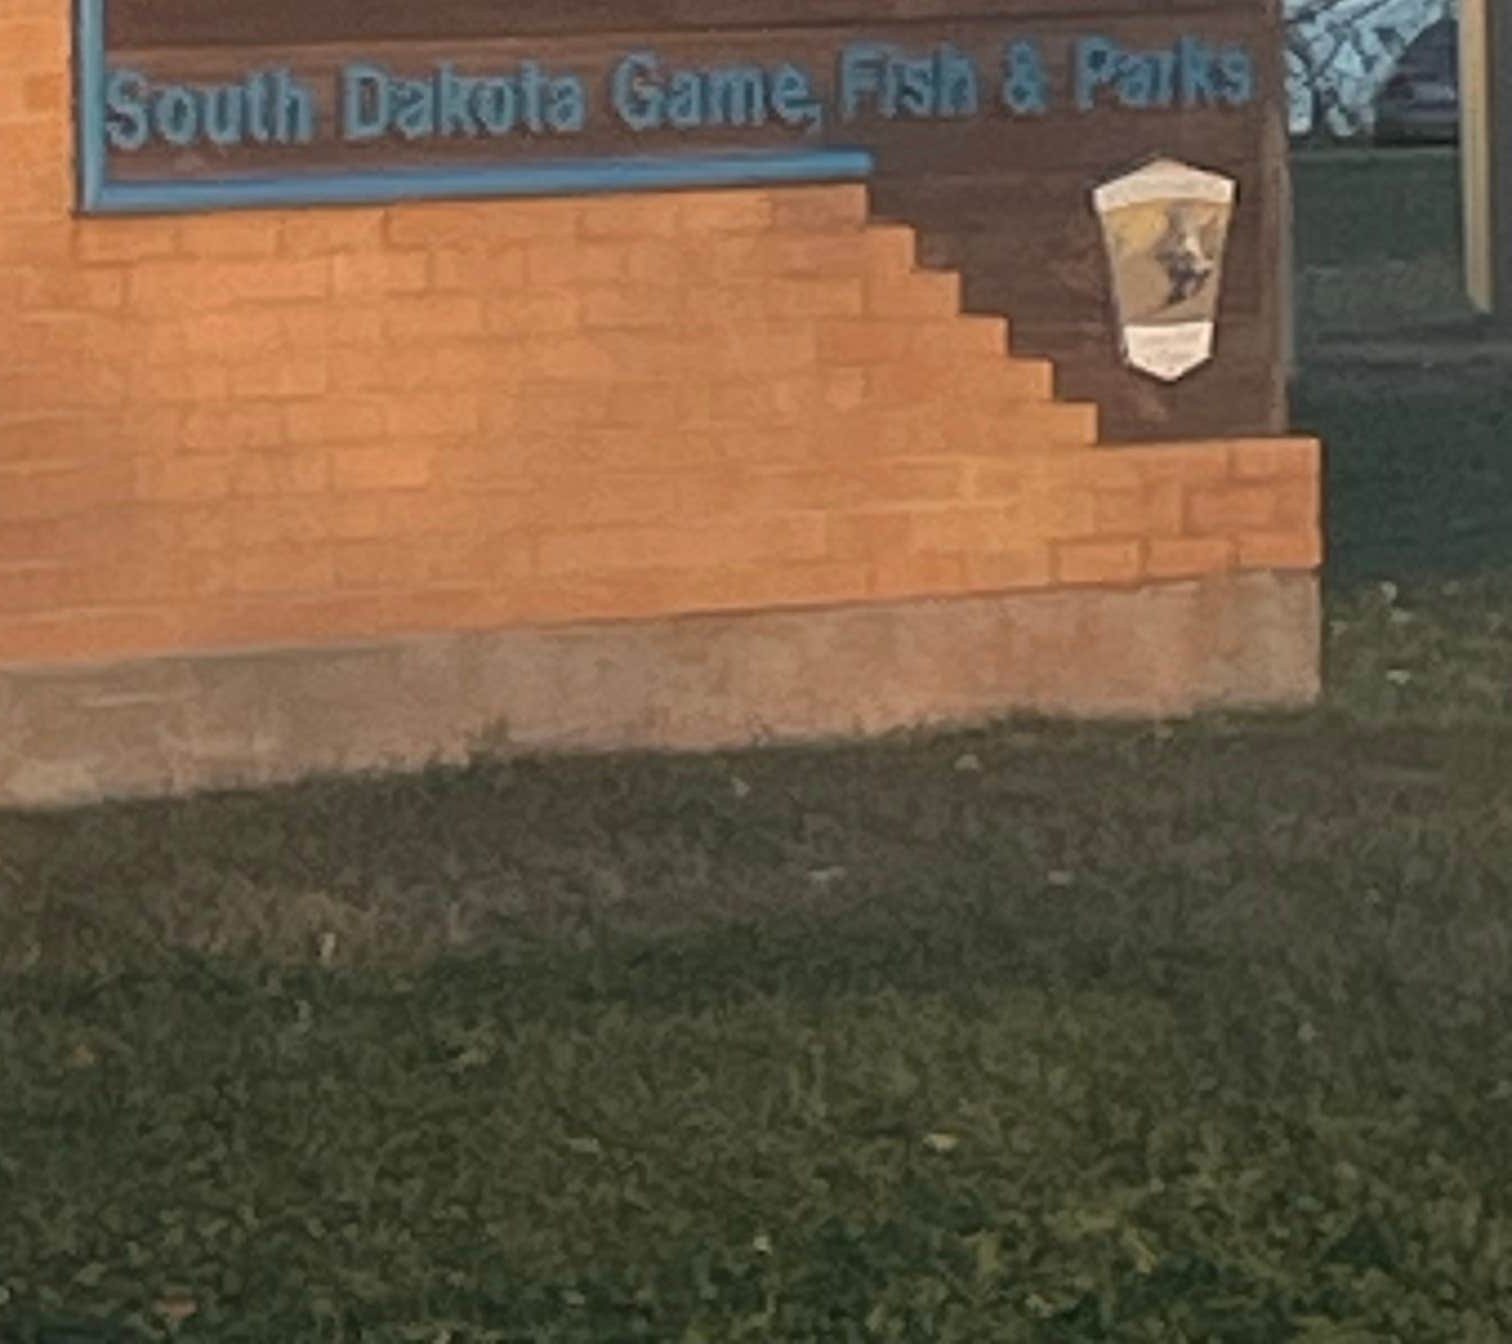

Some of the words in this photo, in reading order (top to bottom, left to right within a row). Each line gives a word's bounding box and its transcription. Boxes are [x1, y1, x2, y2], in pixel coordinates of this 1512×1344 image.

[105, 68, 314, 149] South
[342, 62, 582, 141] Dakota
[612, 50, 822, 132] Game,
[840, 44, 978, 116] Fish
[1003, 39, 1046, 112] &
[1075, 34, 1254, 109] Parks
